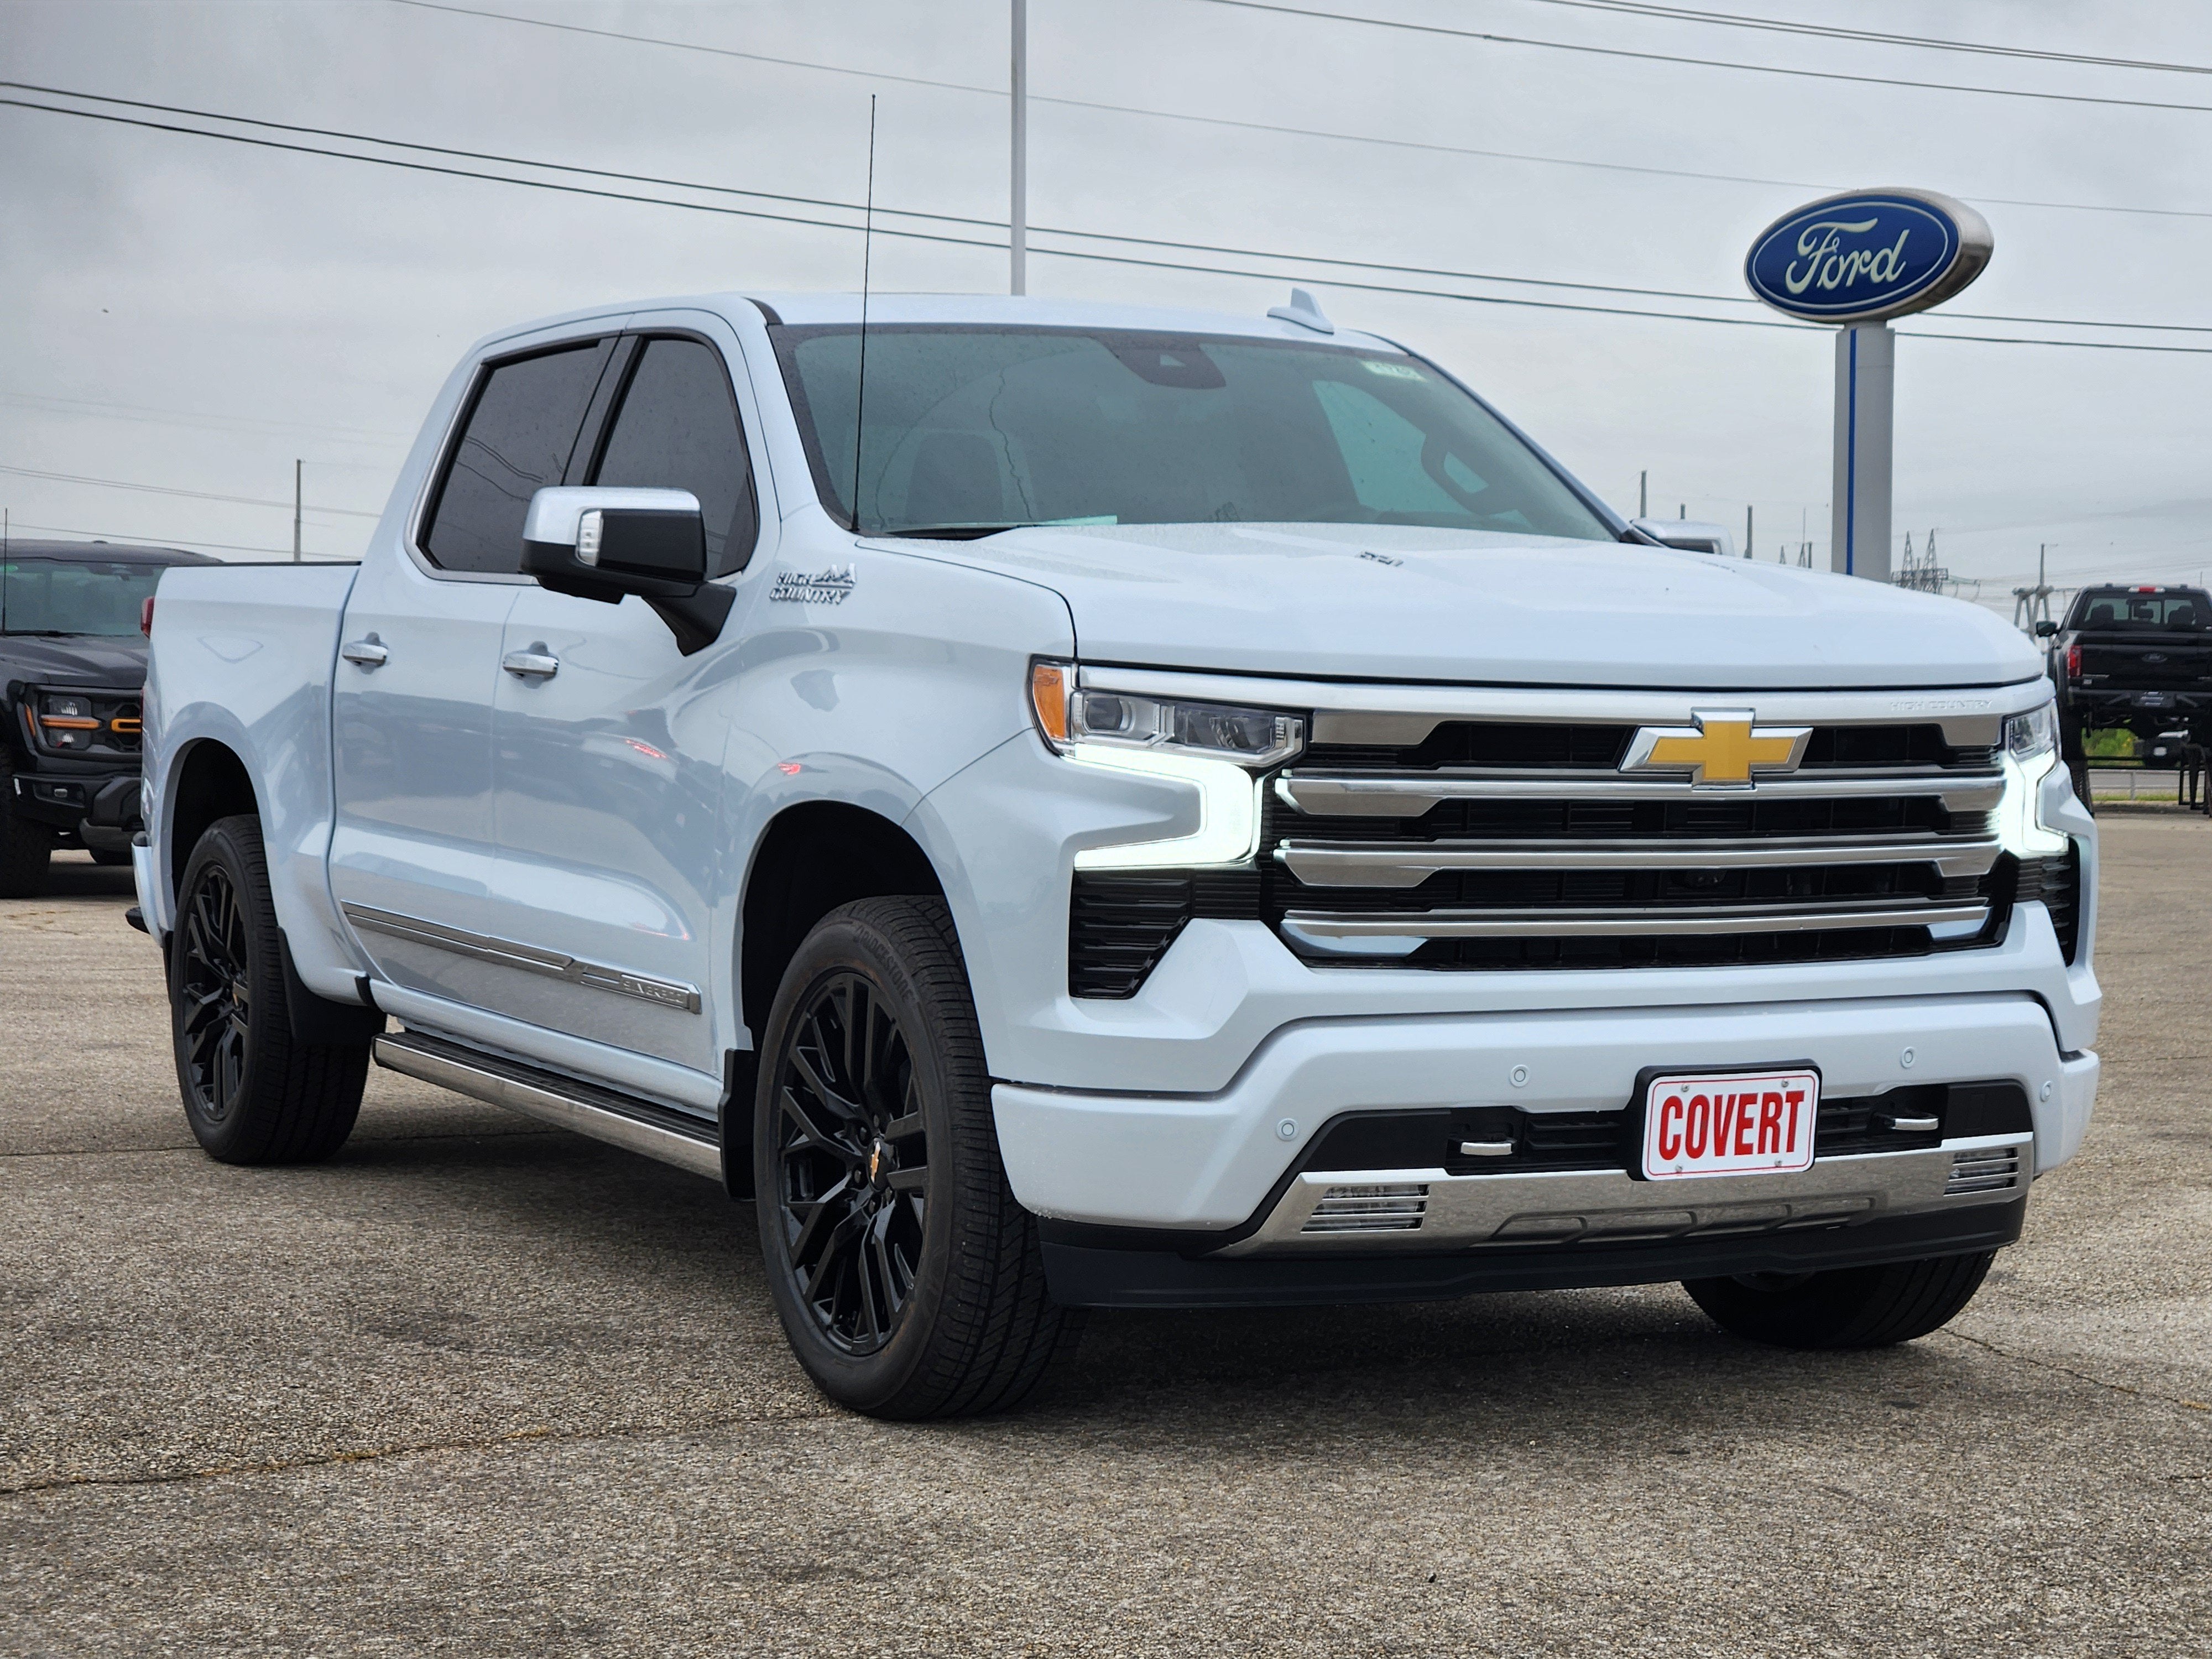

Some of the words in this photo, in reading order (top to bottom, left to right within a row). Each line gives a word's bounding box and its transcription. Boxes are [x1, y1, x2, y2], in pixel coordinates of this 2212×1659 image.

[1786, 217, 1910, 294] Ford
[769, 587, 851, 605] COUNTRY
[1890, 701, 1924, 711] HIGH
[1929, 699, 1992, 709] COUNTRY
[1659, 1090, 1806, 1160] COVERT
